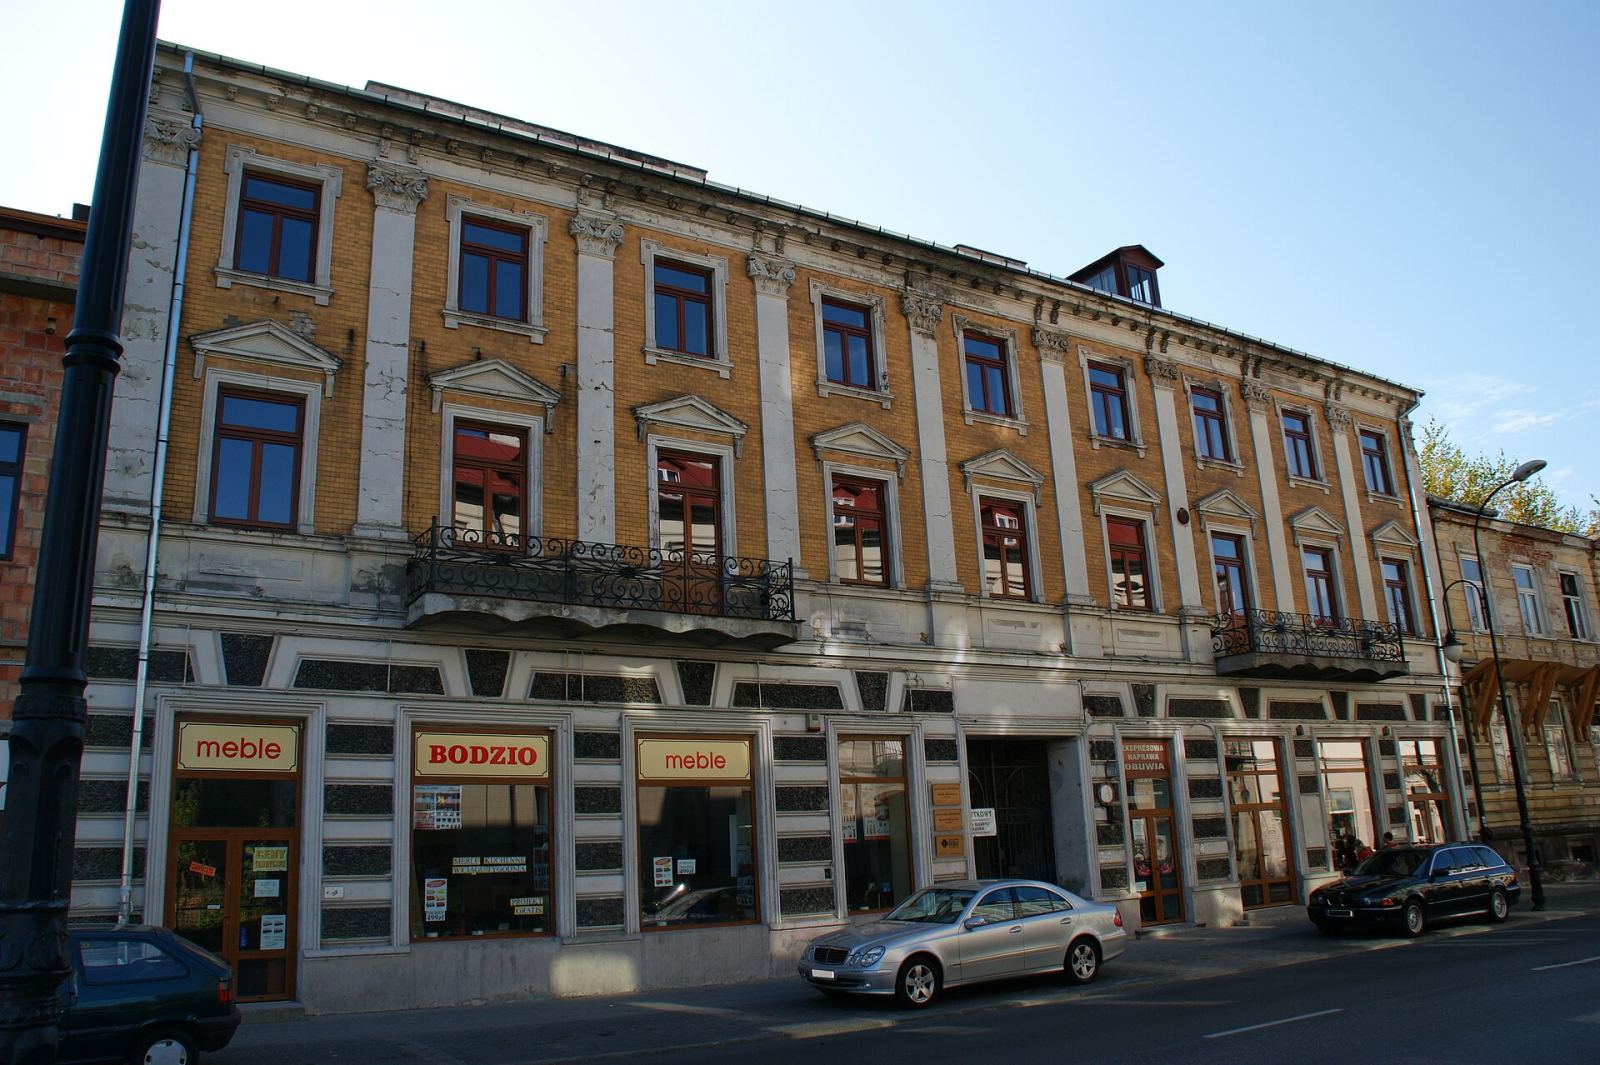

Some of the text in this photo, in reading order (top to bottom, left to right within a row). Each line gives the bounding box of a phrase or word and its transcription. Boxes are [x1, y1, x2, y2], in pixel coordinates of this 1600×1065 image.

[197, 738, 281, 759] meble
[1121, 744, 1164, 752] EKSPRESOWA
[428, 745, 538, 766] BODZIO
[665, 751, 726, 769] meble
[1128, 753, 1159, 761] NAPRAWA
[1124, 763, 1165, 771] OBUWIA
